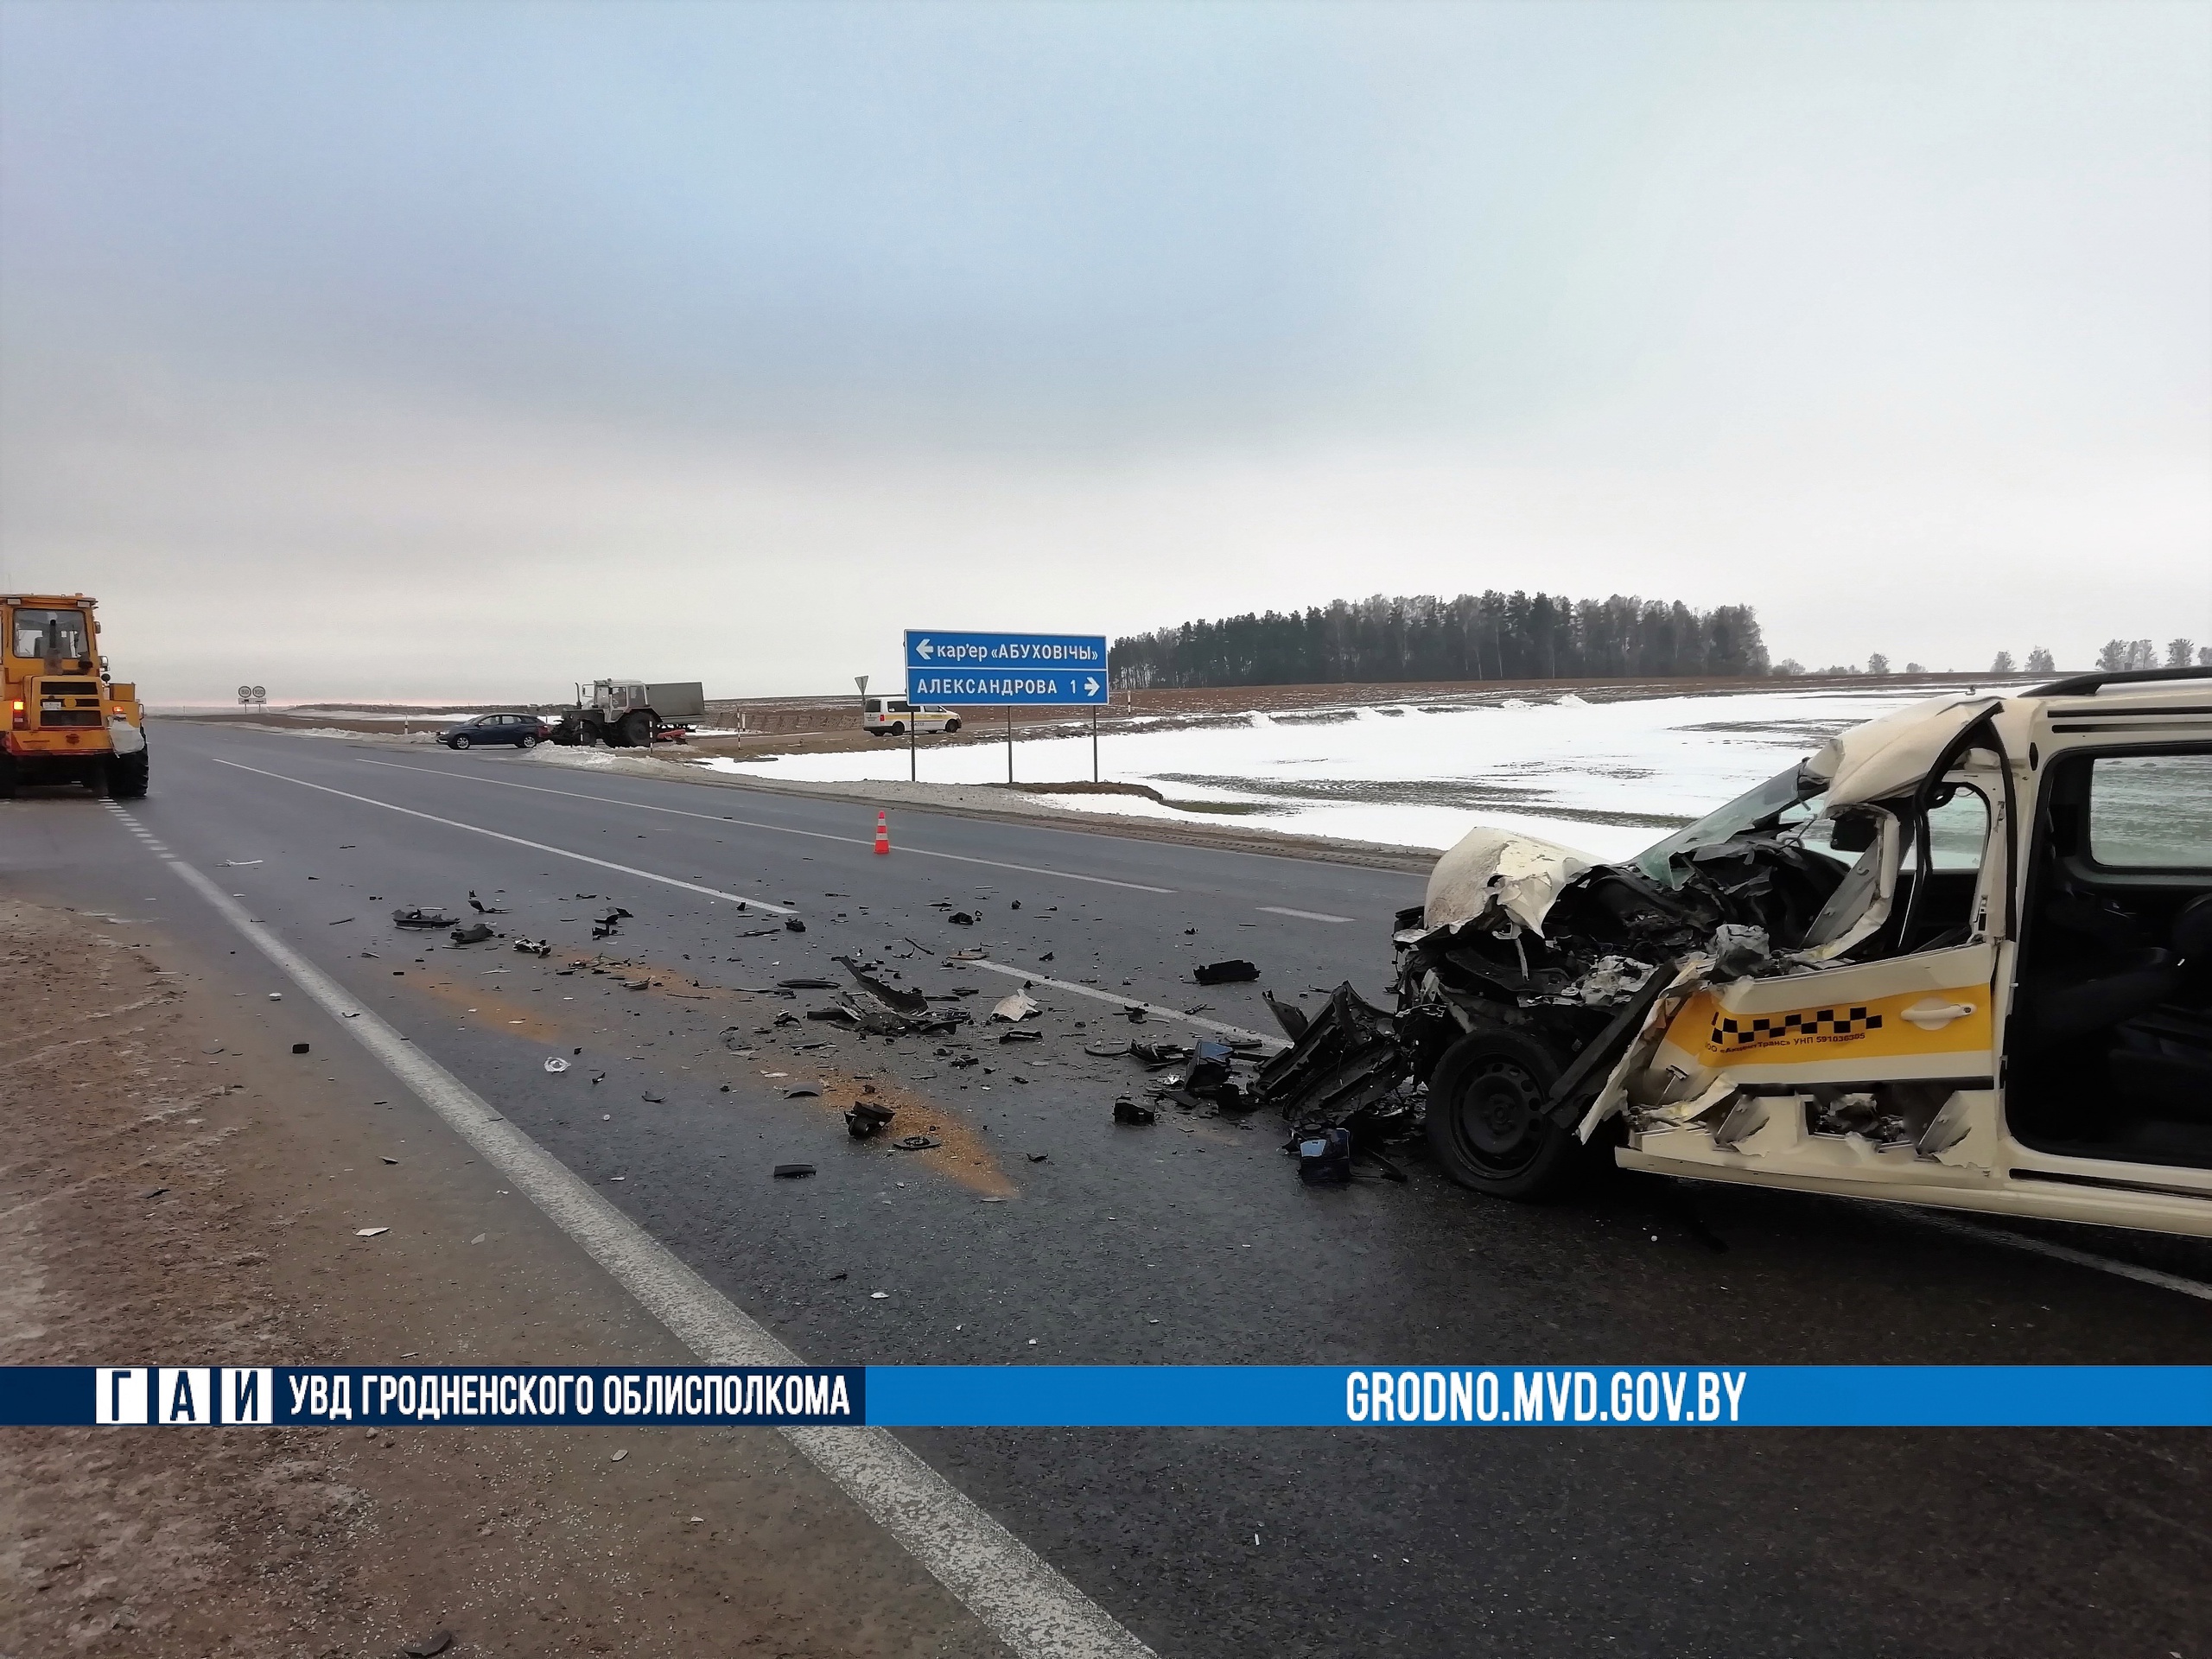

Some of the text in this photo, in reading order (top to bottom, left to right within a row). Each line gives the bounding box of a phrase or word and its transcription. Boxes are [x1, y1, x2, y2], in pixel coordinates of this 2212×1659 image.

[917, 678, 1077, 696] АЛЕКСАНДРОВА 1
[1794, 1037, 1814, 1046] УНП
